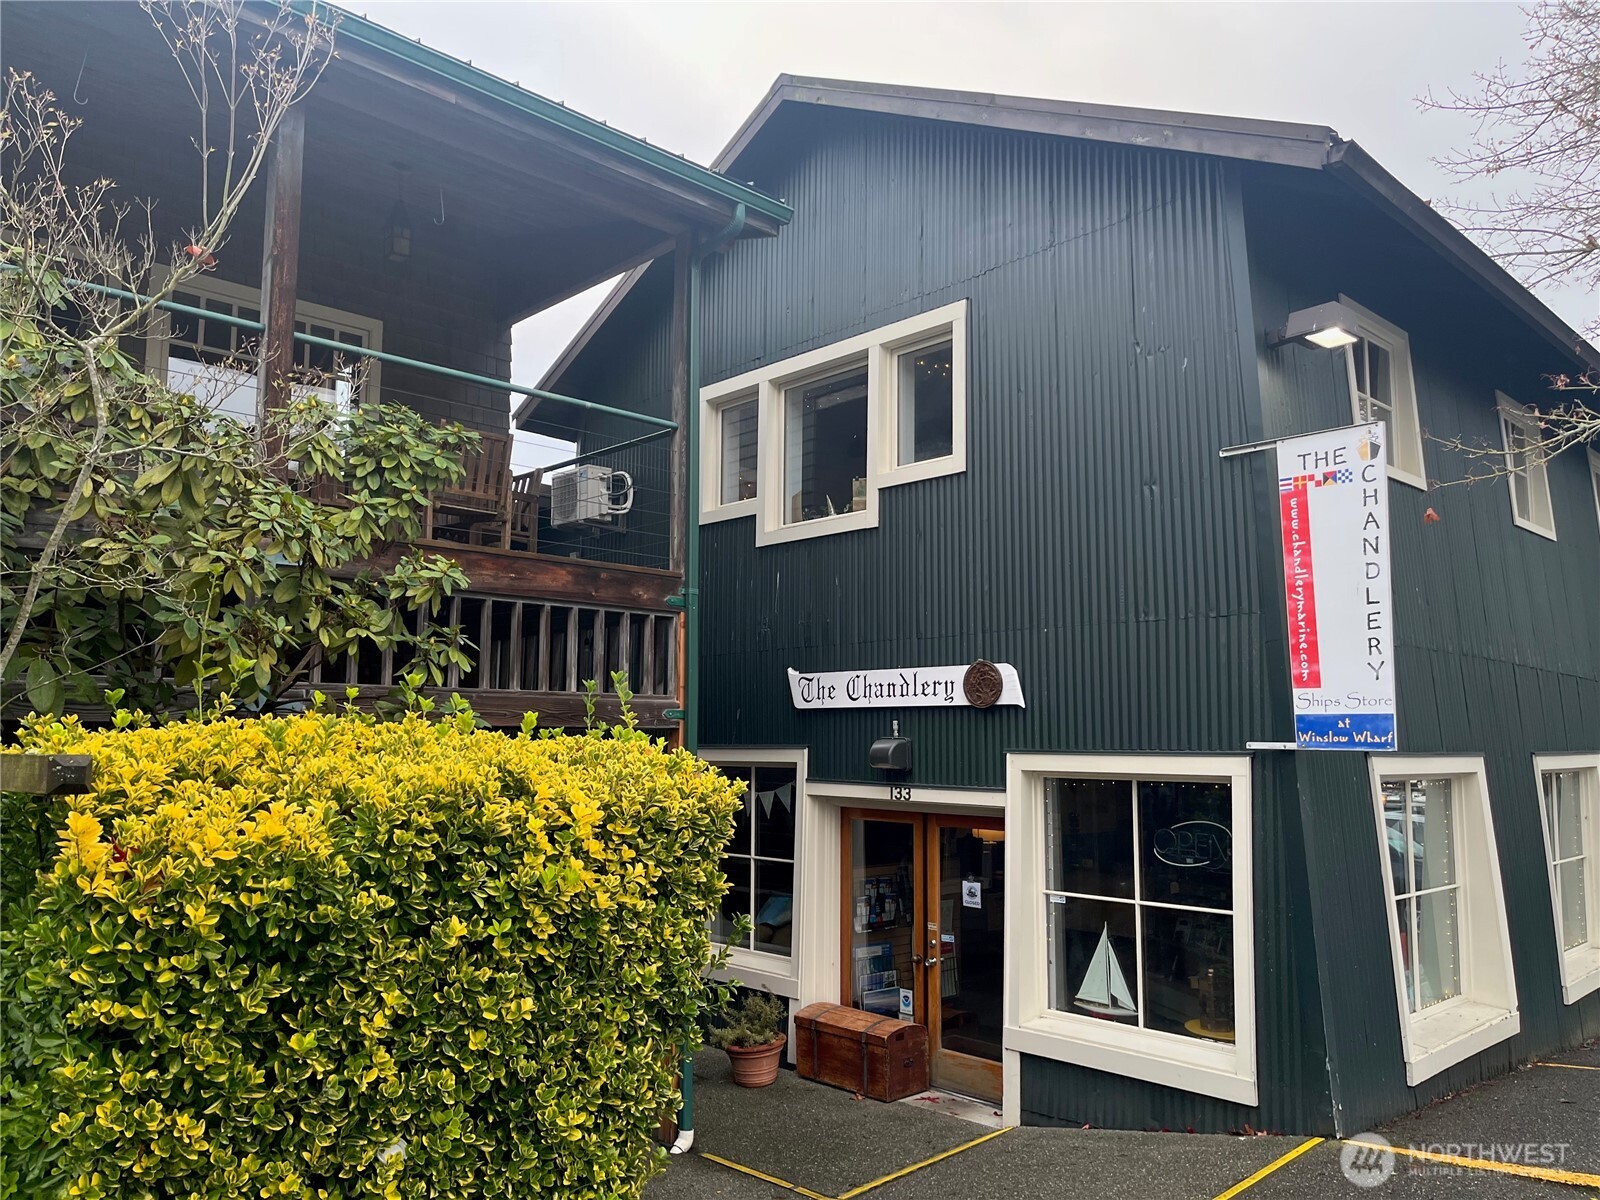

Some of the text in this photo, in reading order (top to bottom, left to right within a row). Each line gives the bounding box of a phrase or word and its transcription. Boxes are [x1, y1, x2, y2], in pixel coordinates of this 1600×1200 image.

[1297, 446, 1347, 470] THE
[1361, 464, 1385, 681] CHANDLERY
[1290, 497, 1311, 681] www.chandlerymarine.com
[798, 671, 955, 705] The Chandlery
[1296, 691, 1393, 712] Ships Store
[1337, 718, 1351, 728] at
[1298, 731, 1393, 743] Winslow Wharf
[890, 786, 912, 801] 133
[1153, 828, 1231, 861] OPEN
